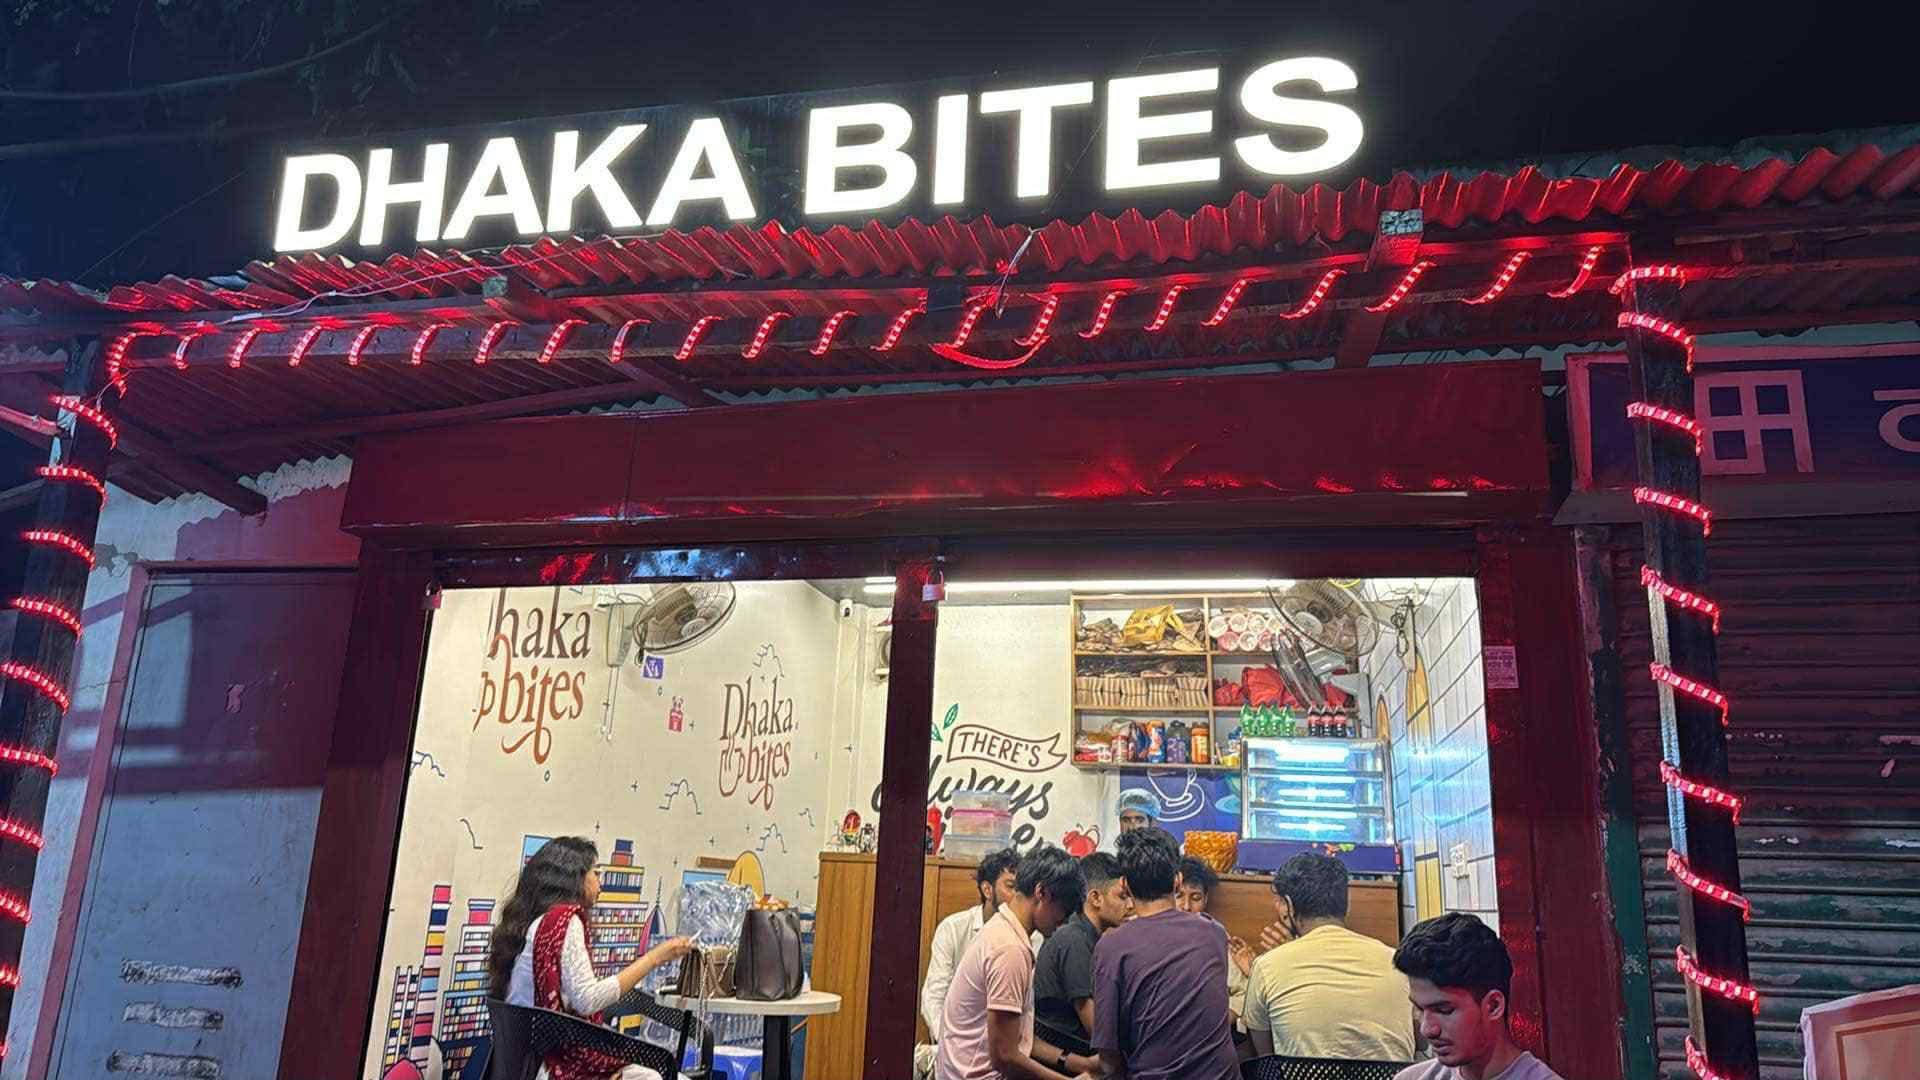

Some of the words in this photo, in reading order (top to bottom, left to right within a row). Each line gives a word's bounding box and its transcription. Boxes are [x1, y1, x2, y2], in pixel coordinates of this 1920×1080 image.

[274, 117, 757, 253] DHAKA
[803, 57, 1365, 216] BITES
[720, 675, 794, 741] Dhaka
[958, 731, 1042, 768] THERE'S
